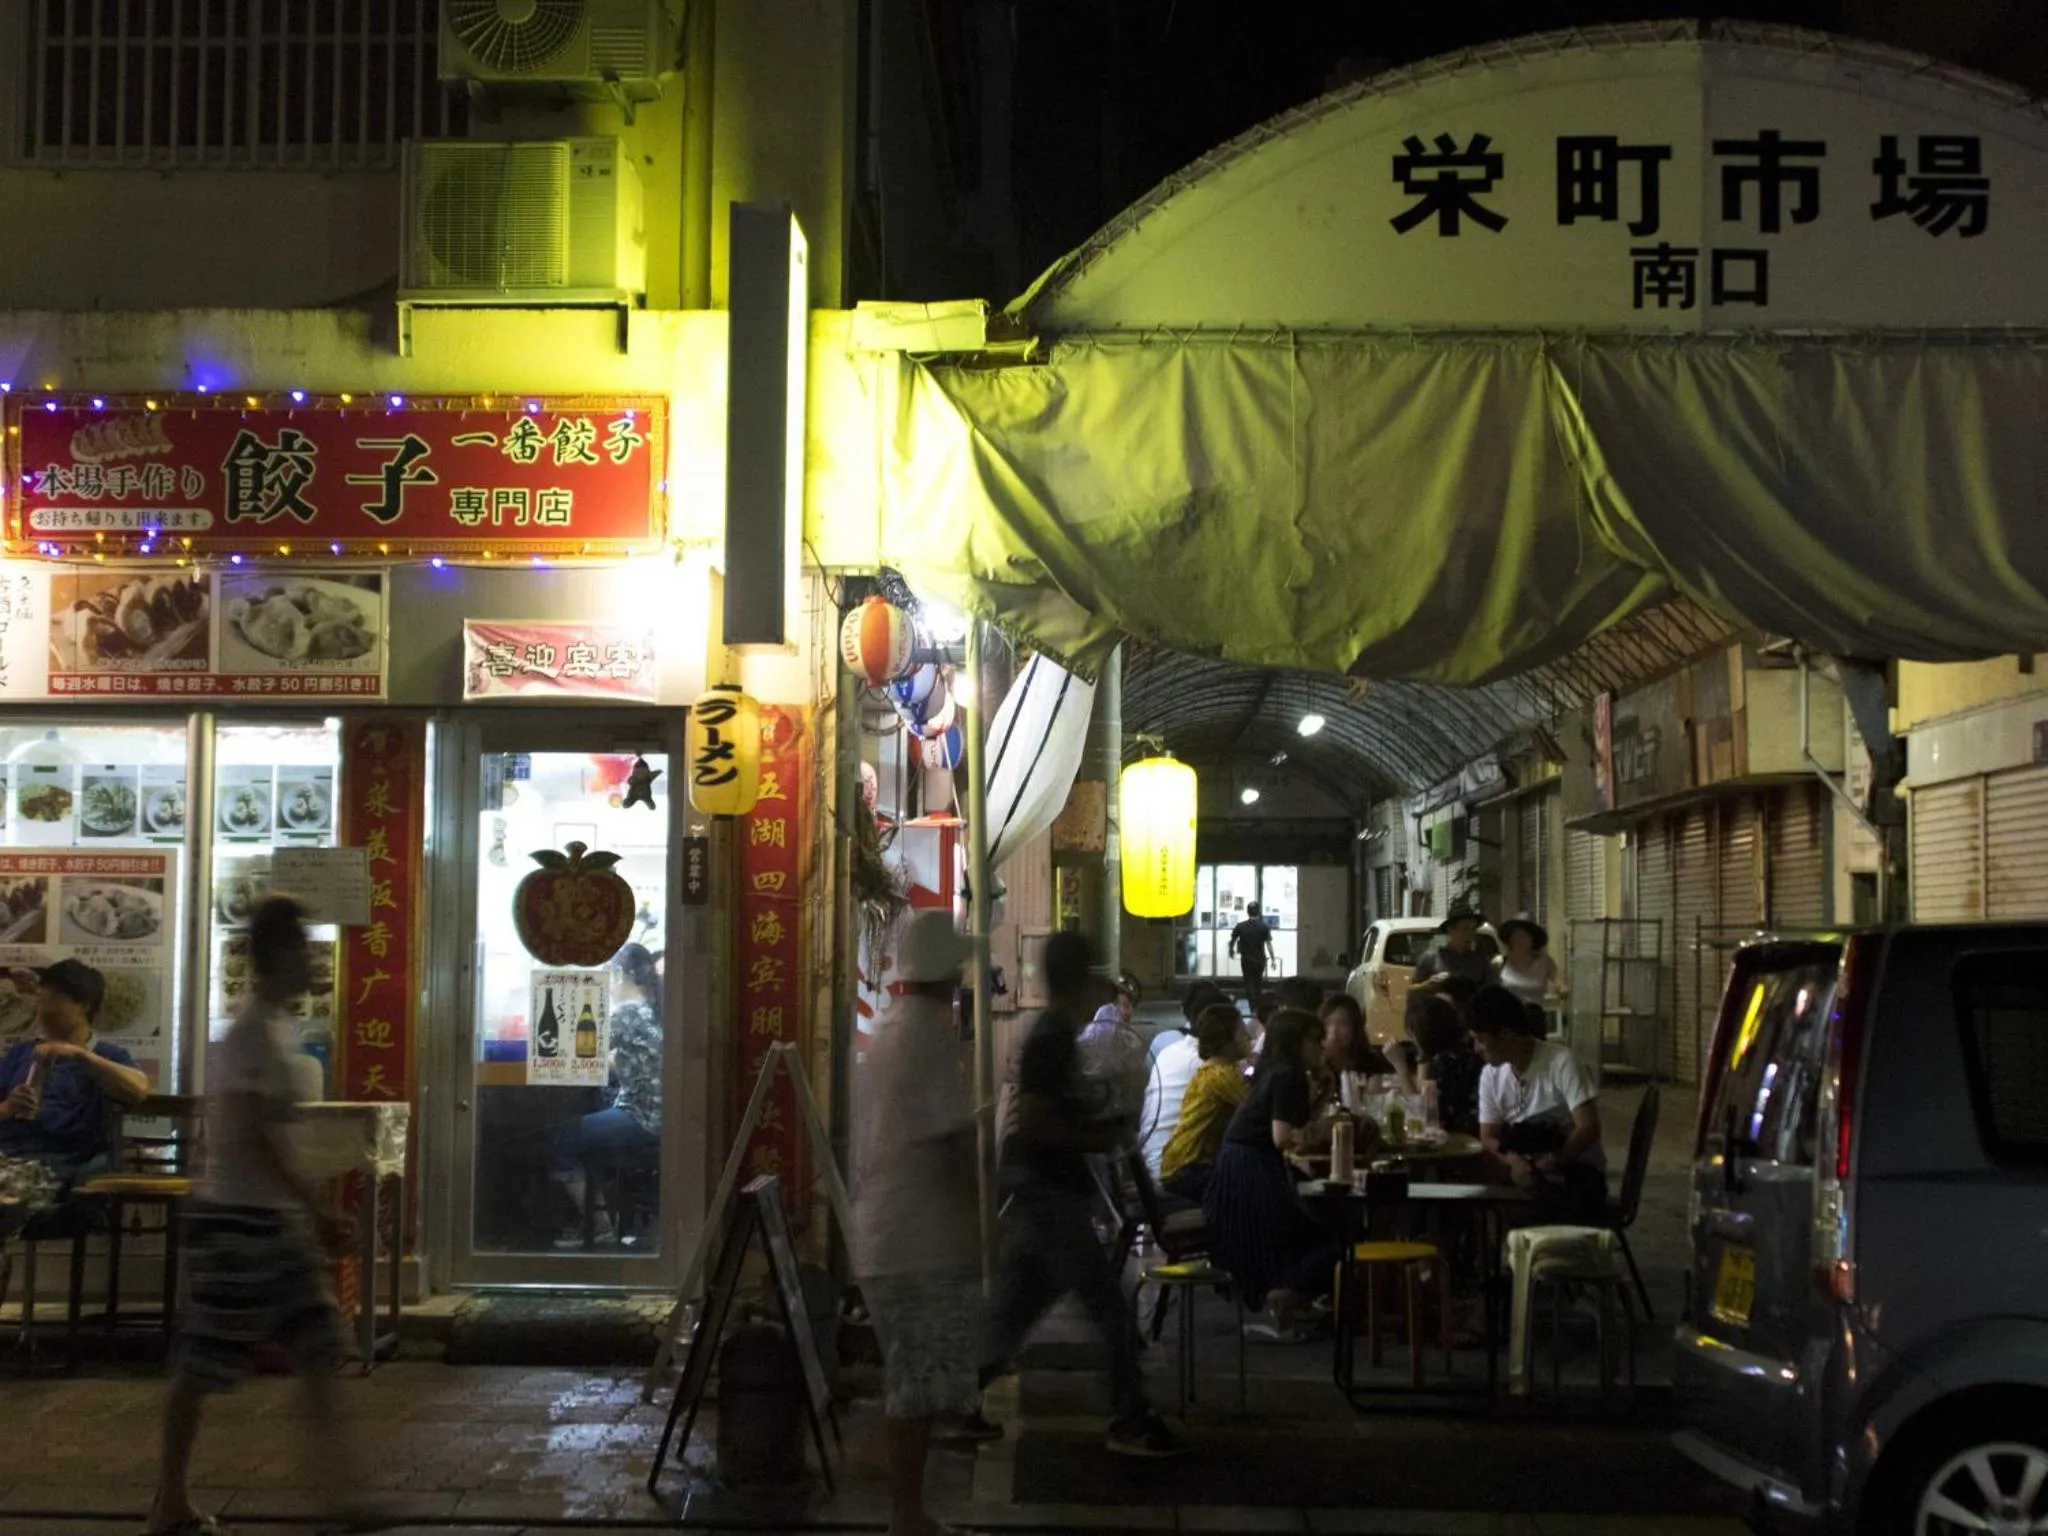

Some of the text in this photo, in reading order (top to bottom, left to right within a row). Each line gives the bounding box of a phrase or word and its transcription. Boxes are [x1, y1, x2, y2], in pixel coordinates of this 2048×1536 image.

[1390, 130, 1990, 238] 栄町市場
[1629, 242, 1770, 310] 南口
[452, 417, 643, 465] 一番餃子
[34, 463, 205, 501] 本場手作り
[221, 429, 439, 524] 餃子
[450, 488, 573, 525] 専門店
[694, 698, 738, 787] ラーメン
